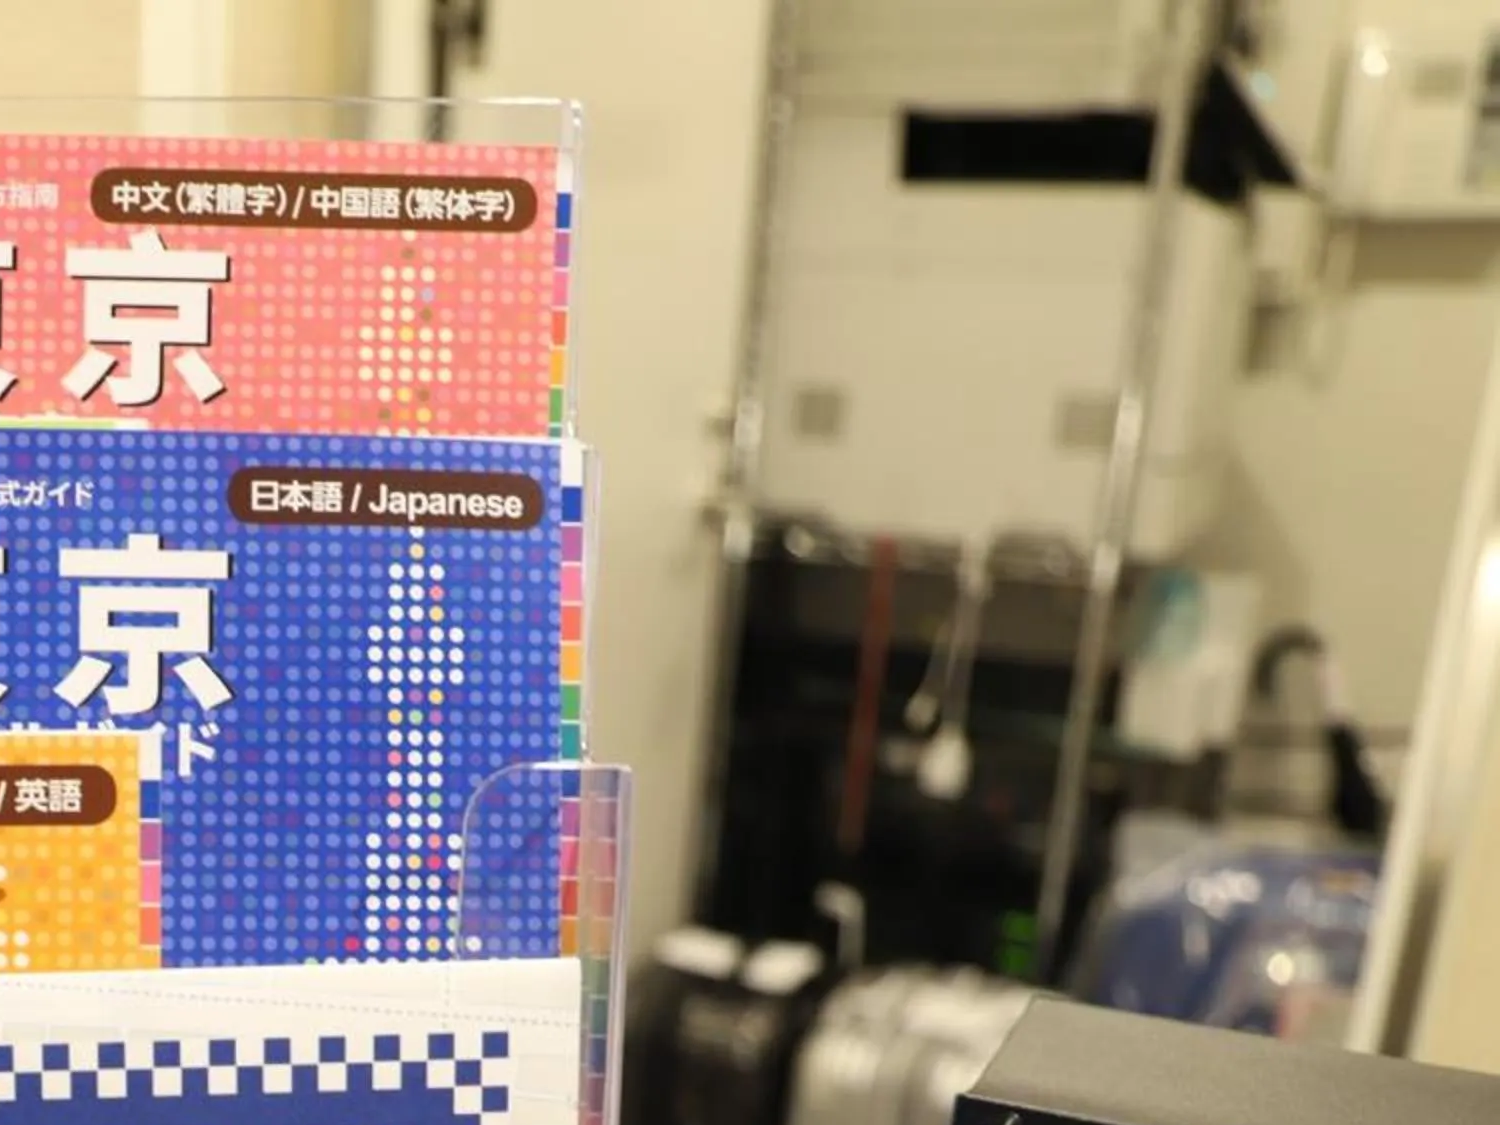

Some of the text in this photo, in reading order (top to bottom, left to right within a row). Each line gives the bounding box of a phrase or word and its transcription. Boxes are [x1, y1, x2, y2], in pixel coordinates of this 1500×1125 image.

[250, 480, 343, 513] 日本語
[368, 483, 524, 522] Japanese
[13, 777, 83, 814] 英語
